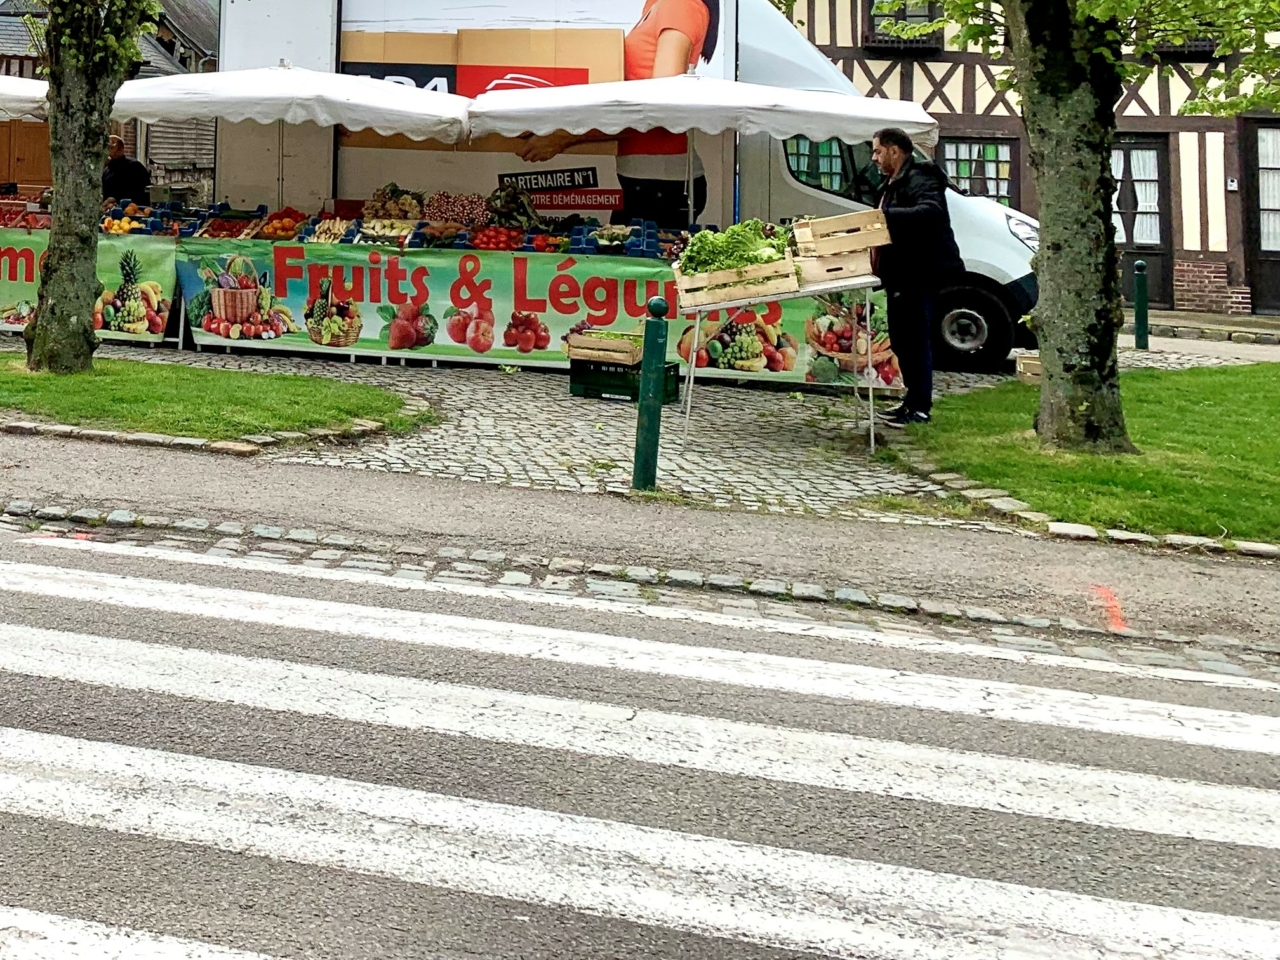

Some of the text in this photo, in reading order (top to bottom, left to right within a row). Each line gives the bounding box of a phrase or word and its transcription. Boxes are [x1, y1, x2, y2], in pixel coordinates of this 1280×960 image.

[552, 192, 621, 206] DÉMÉNAGEMENT
[272, 244, 430, 307] Fruits
[448, 252, 494, 311] &
